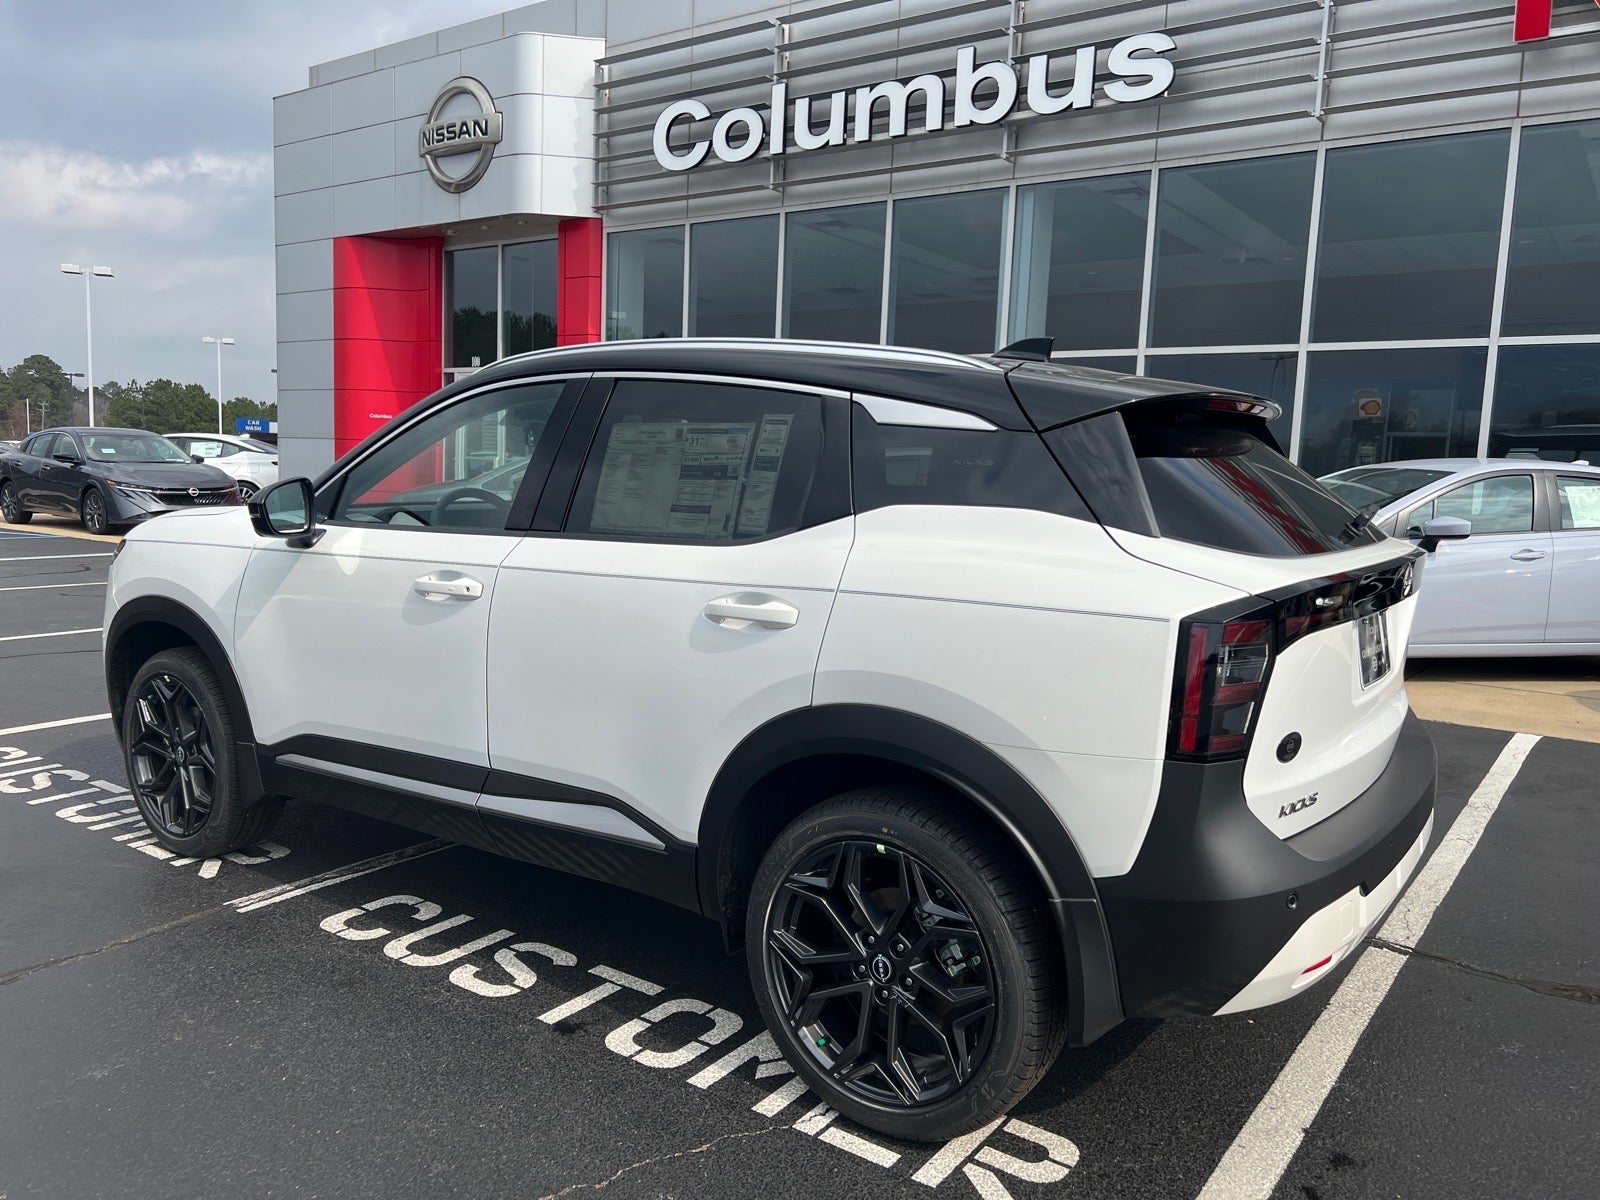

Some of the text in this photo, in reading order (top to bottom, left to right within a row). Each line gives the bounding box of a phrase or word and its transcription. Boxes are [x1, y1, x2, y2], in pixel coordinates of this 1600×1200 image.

[652, 32, 1177, 171] Columbus
[422, 118, 489, 148] NISSAN
[471, 356, 480, 367] 100
[1279, 792, 1319, 818] KICKS
